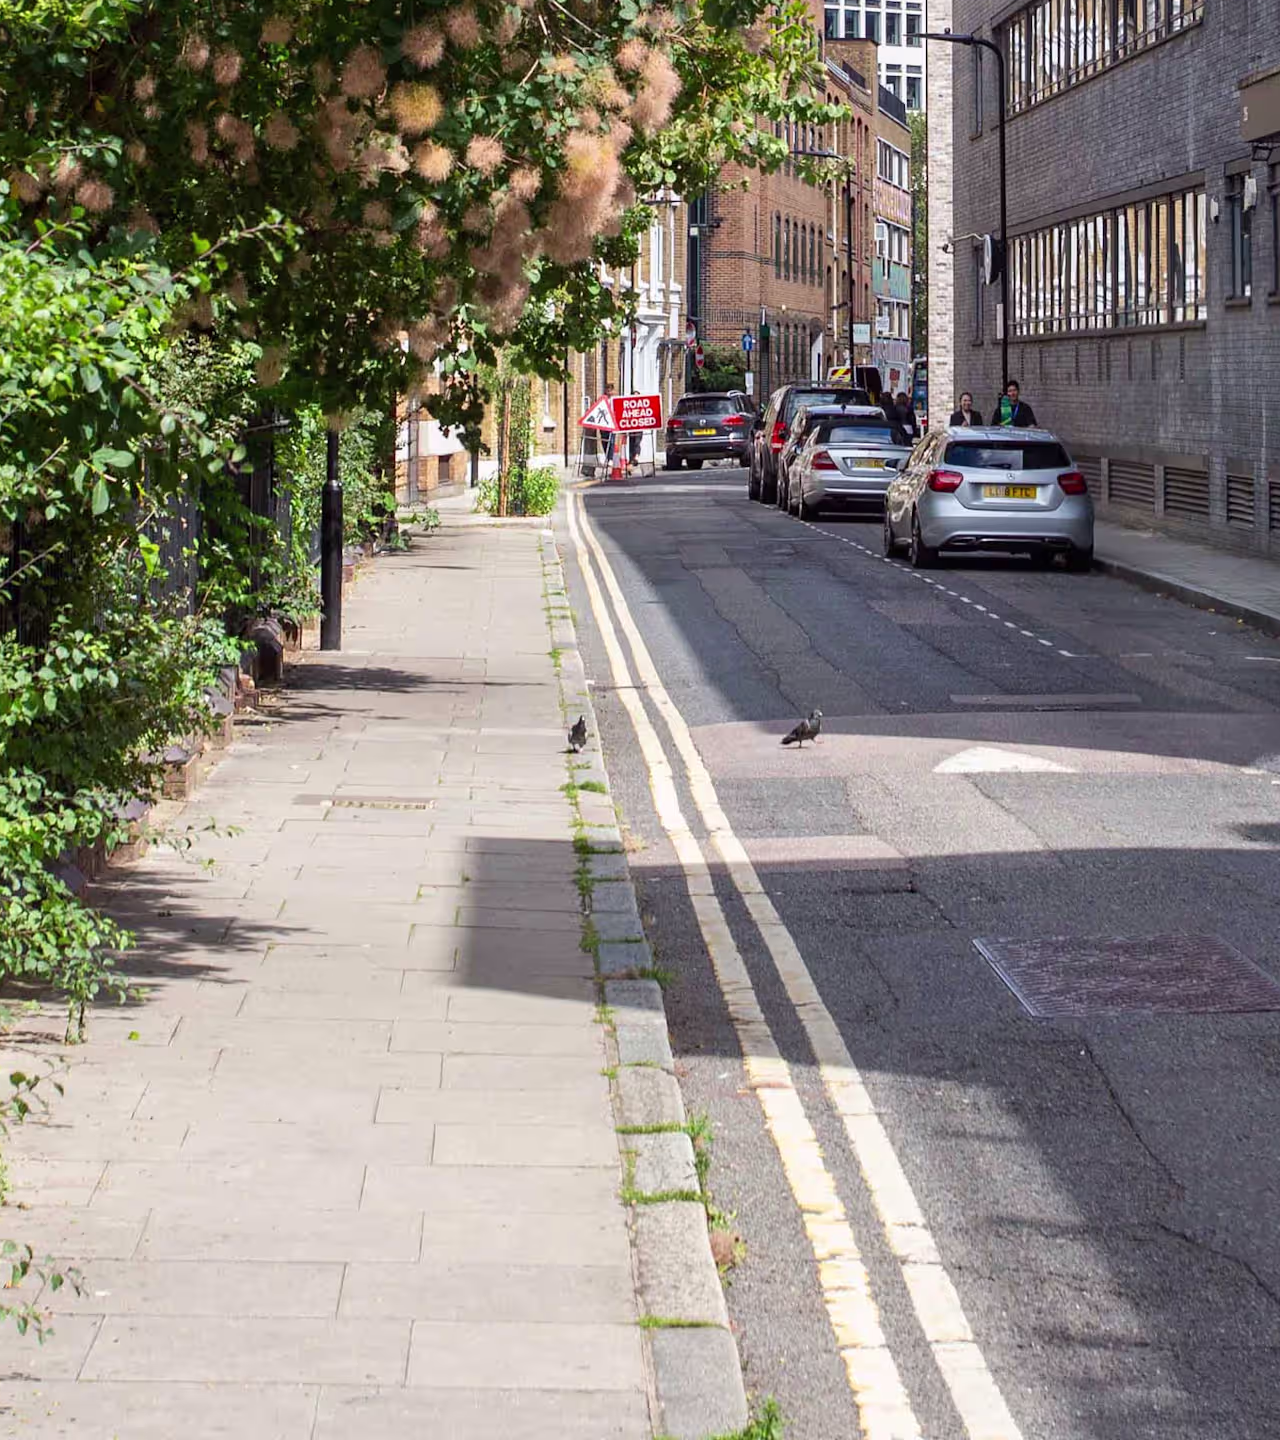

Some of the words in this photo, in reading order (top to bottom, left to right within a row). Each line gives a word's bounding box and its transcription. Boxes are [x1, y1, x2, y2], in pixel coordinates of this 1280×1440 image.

[623, 398, 650, 409] ROAD
[622, 408, 653, 418] AHEAD
[620, 417, 656, 428] CLOSED
